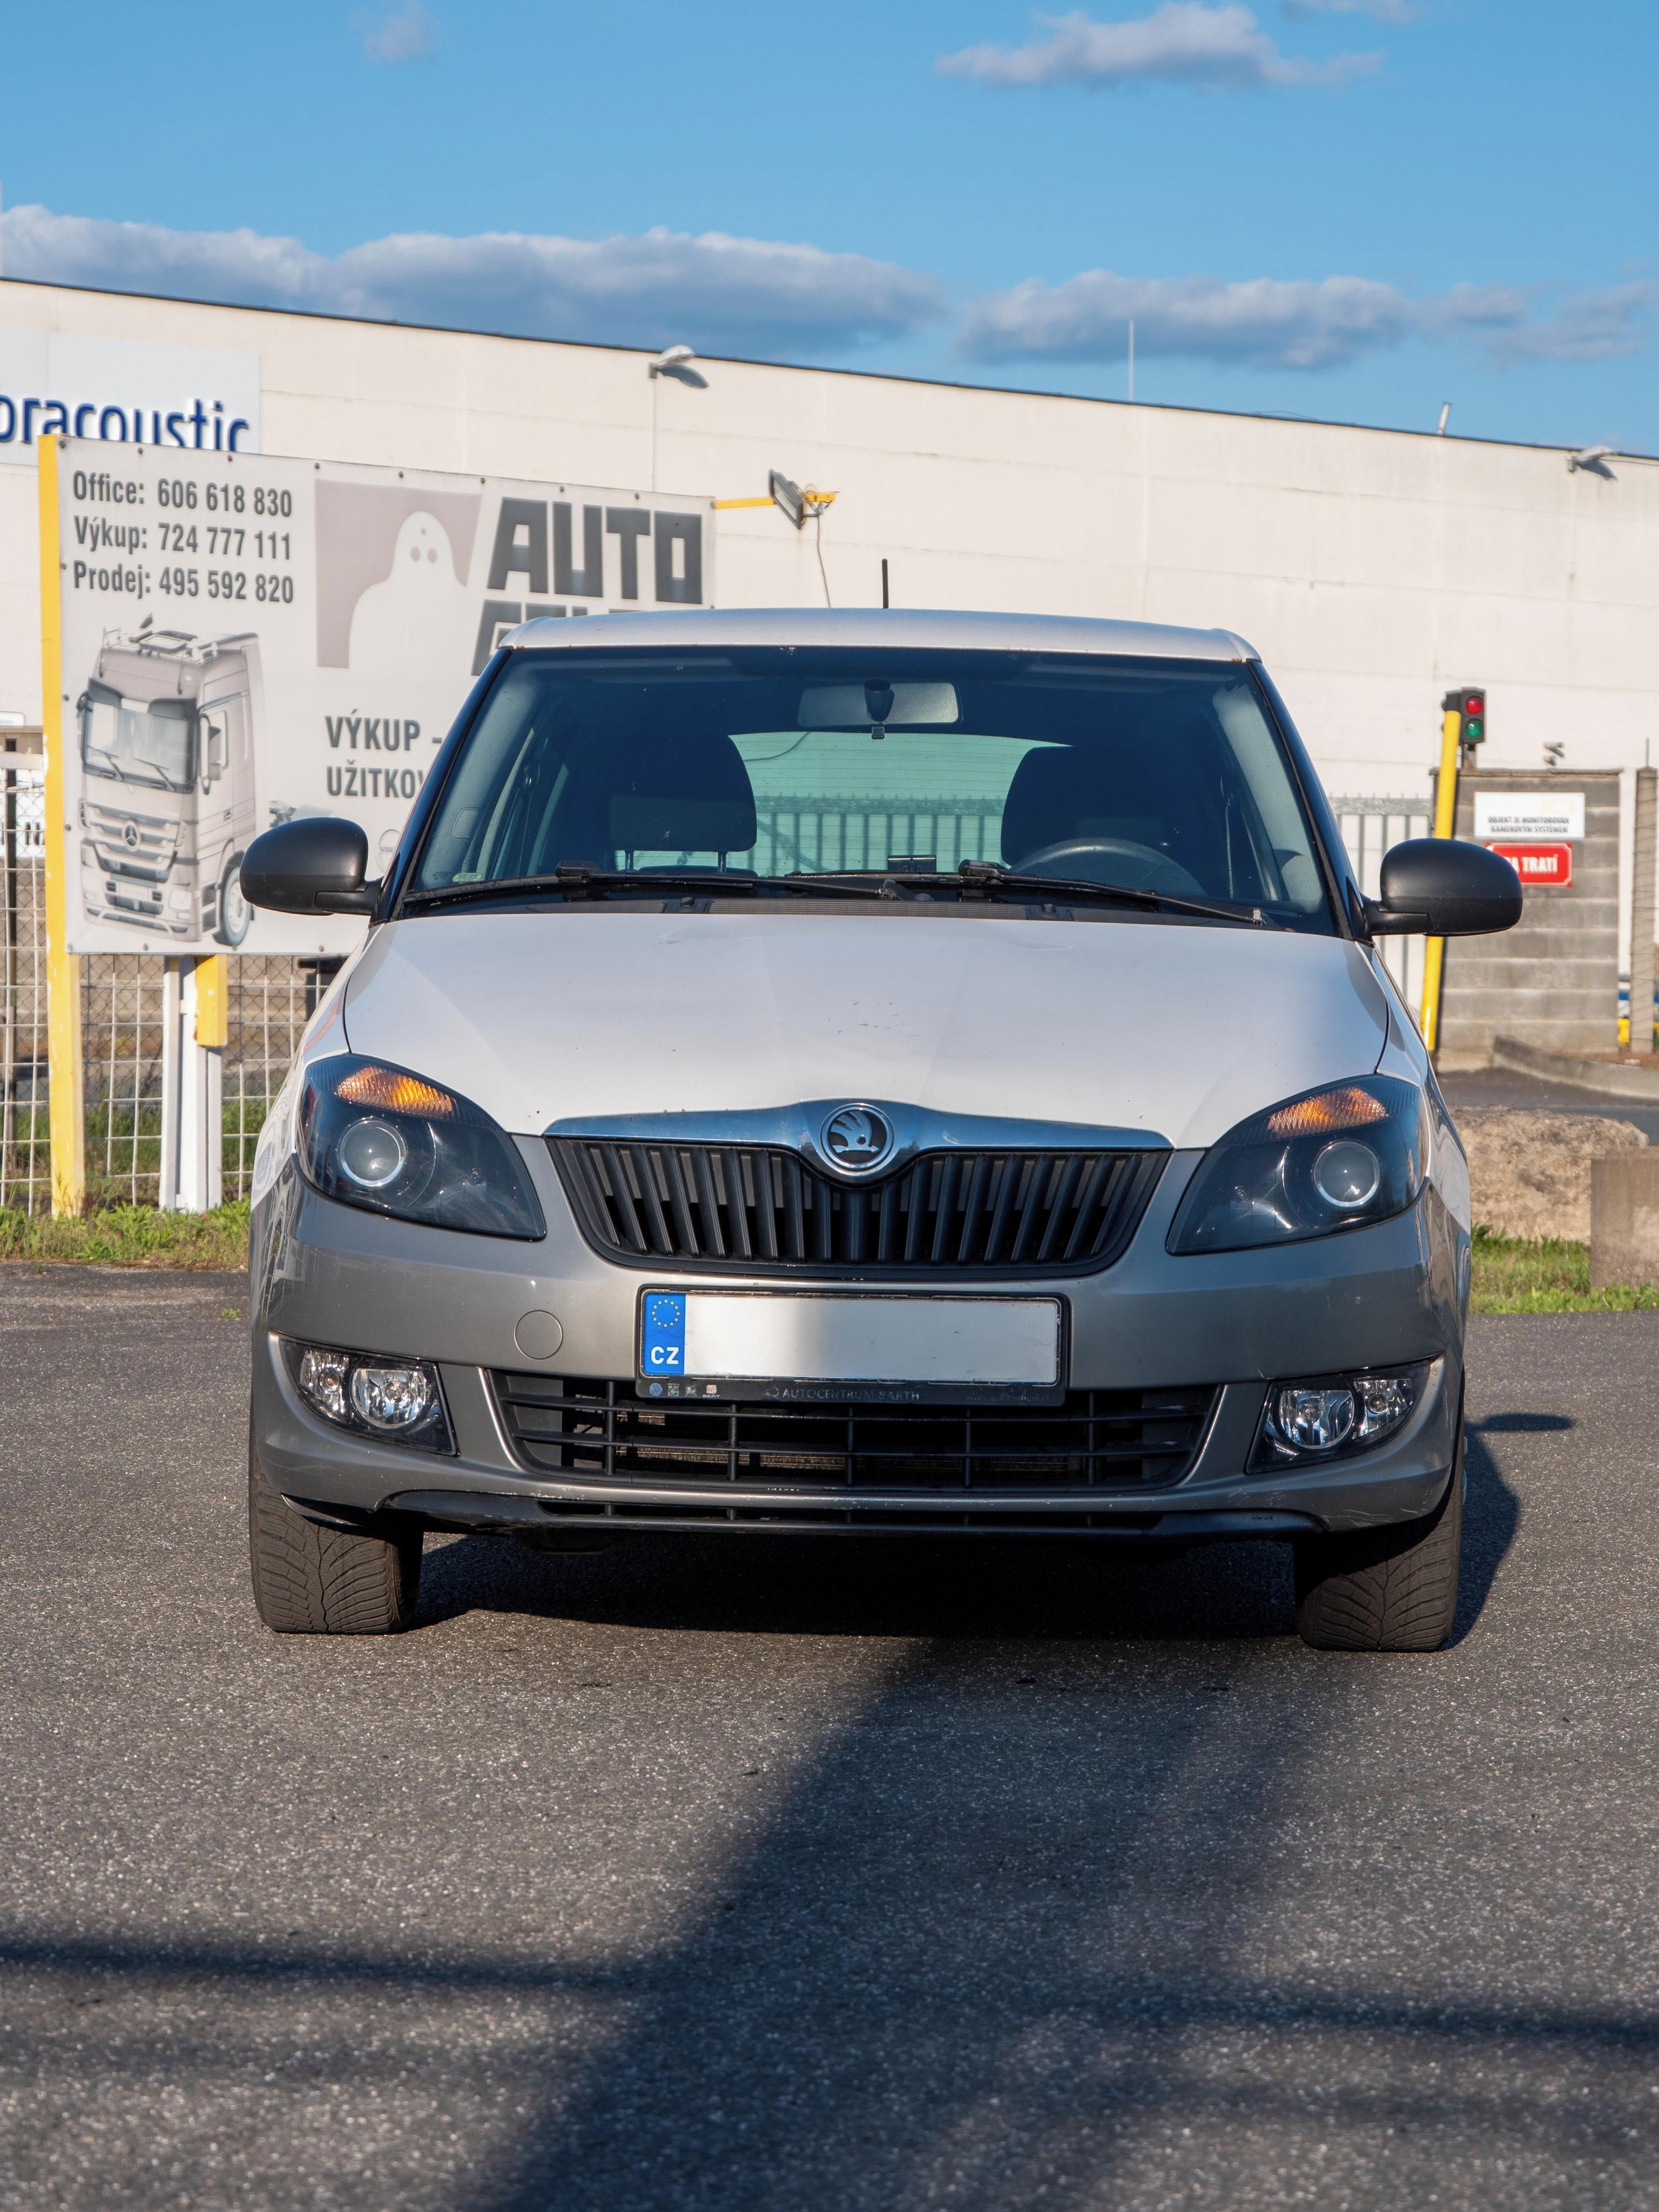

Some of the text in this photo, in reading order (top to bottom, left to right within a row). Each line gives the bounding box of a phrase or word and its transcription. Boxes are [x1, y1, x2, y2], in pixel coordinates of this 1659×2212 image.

[73, 470, 292, 517] Office: 606 618 830
[74, 515, 291, 560] Výkup: 724 777 111
[486, 496, 703, 605] AUTO
[73, 560, 293, 604] Prodej: 495 592 820
[325, 709, 421, 751] VÝKUP
[1521, 854, 1558, 874] TRATÍ
[651, 1346, 679, 1365] CZ
